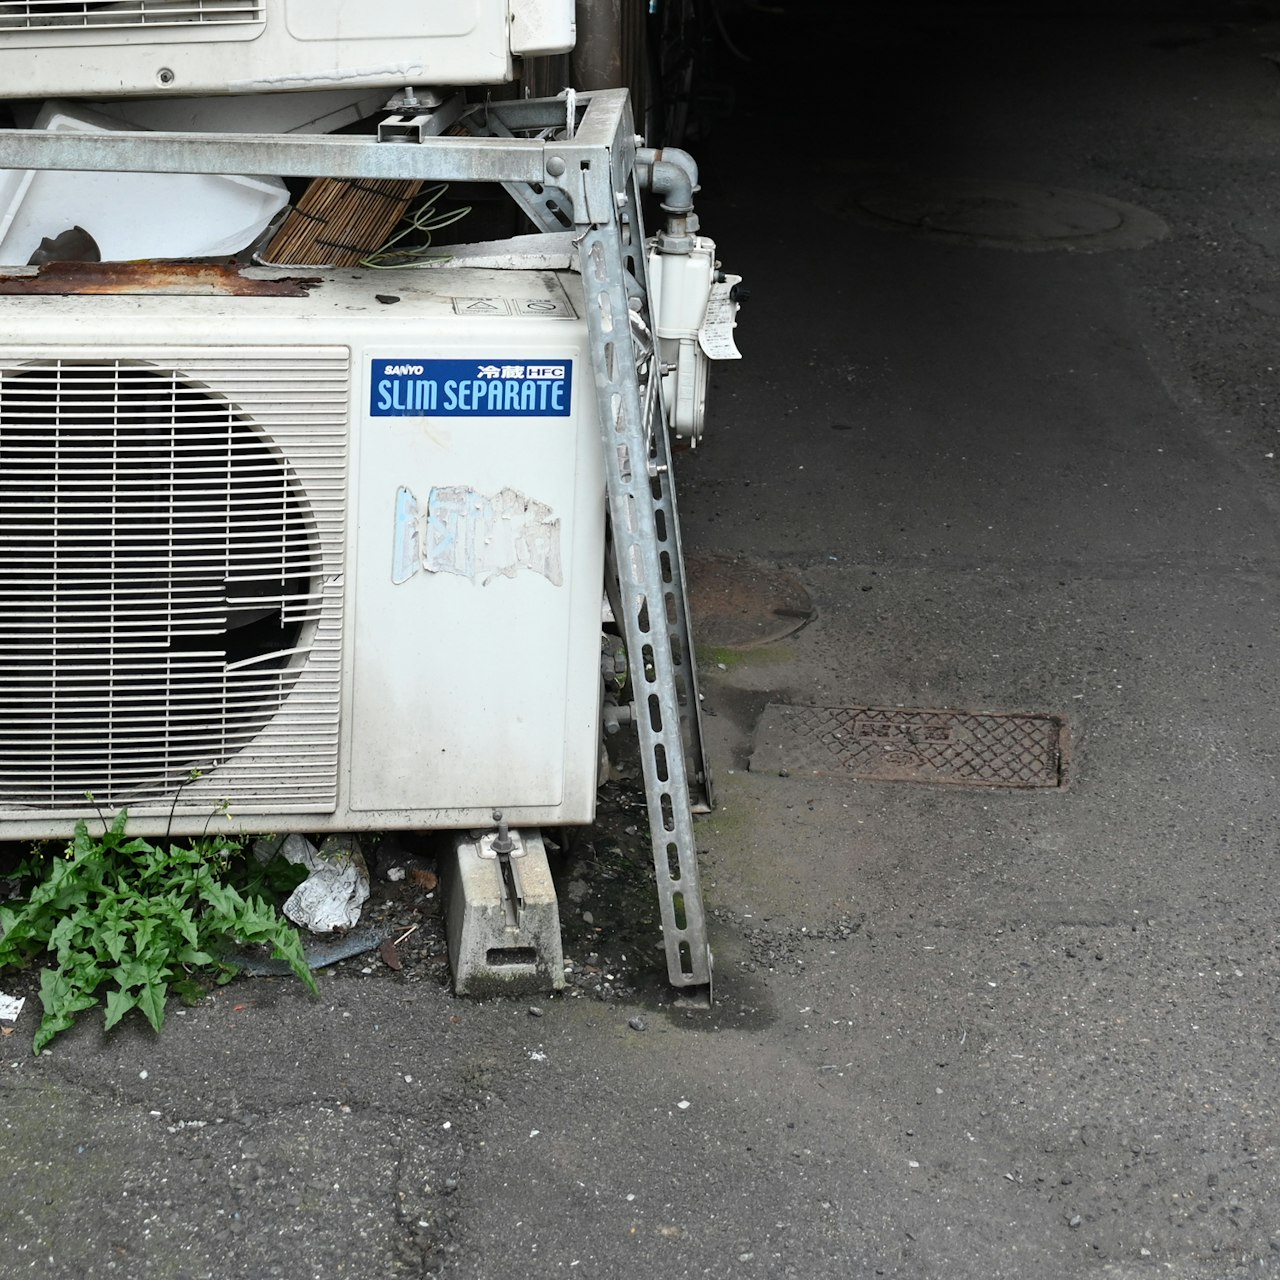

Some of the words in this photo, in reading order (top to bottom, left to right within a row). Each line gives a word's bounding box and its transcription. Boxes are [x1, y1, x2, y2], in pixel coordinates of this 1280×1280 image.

[384, 365, 424, 376] SANYO
[528, 366, 564, 378] HFC
[378, 380, 437, 410] SLIM
[444, 380, 564, 410] SEPARATE
